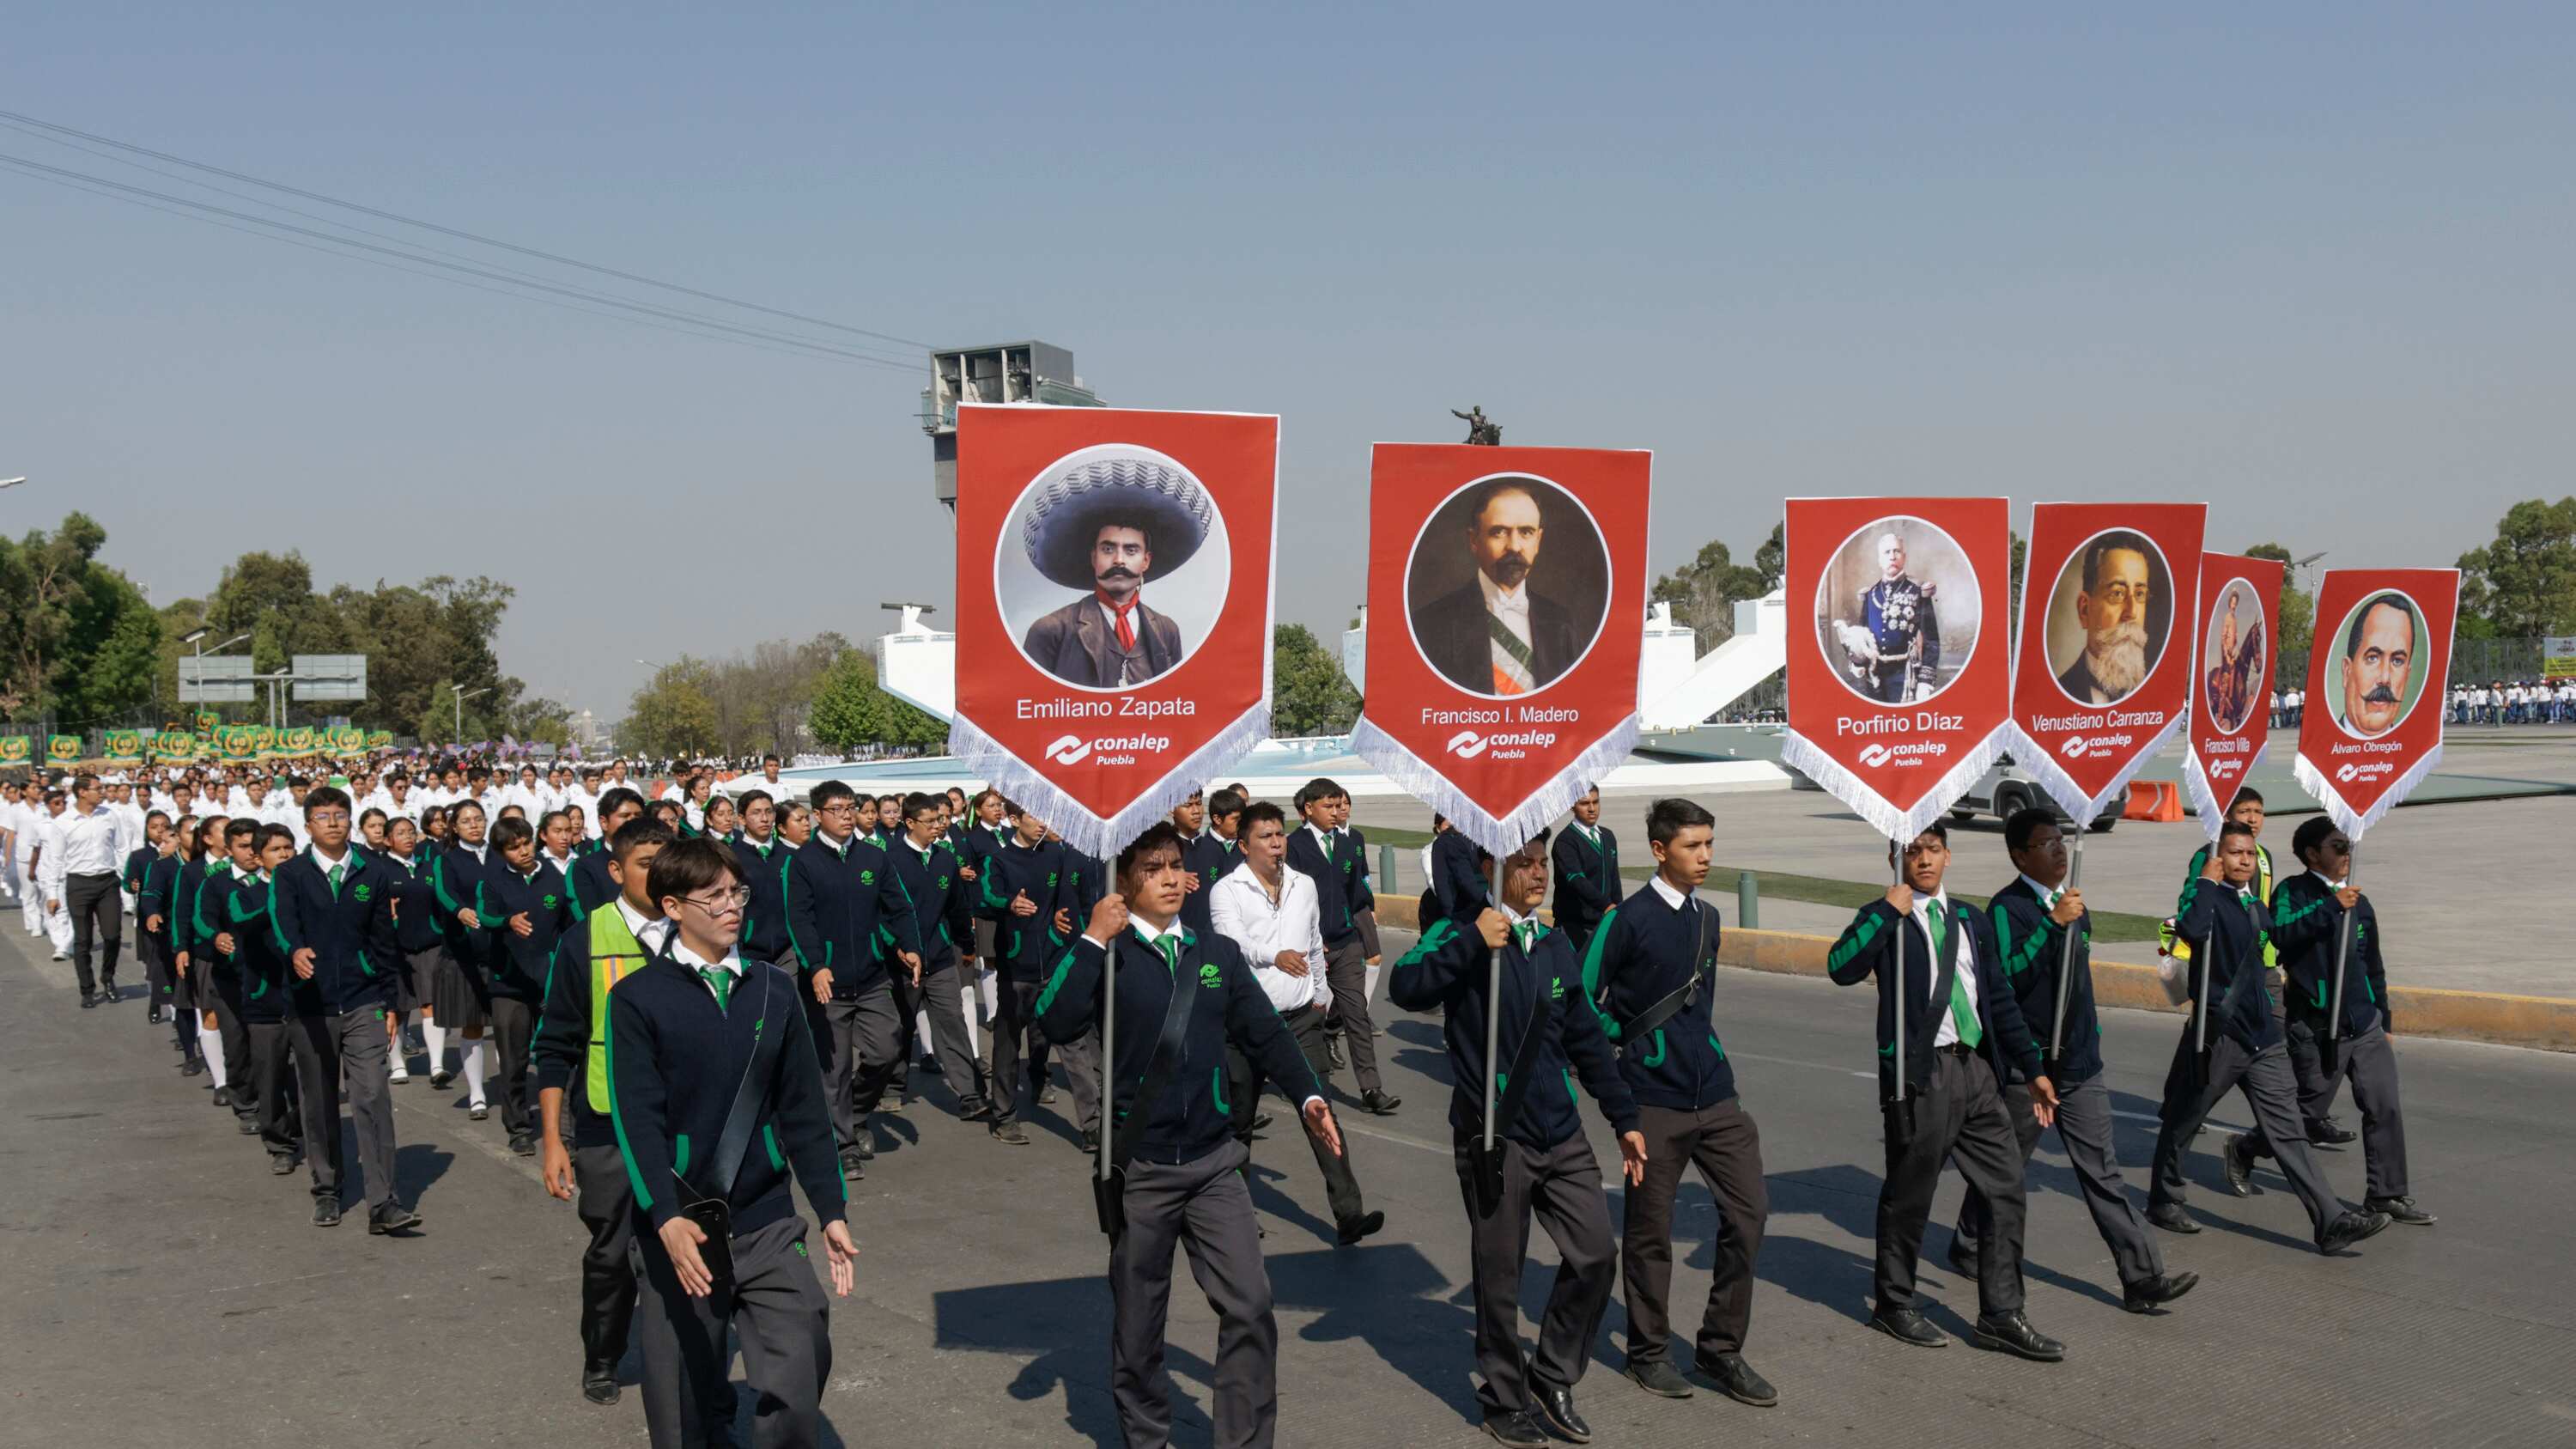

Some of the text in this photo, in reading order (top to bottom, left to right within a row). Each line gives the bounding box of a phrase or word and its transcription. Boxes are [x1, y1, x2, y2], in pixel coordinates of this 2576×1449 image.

[1017, 697, 1196, 720] Emiliano Zapata
[1422, 706, 1579, 725] Francisco I. Madero
[1837, 711, 1964, 736] Porfirio Díaz
[2032, 709, 2164, 732] Venustiano Carranza
[1094, 734, 1170, 754] conalep
[1490, 729, 1556, 747] conalep
[2089, 733, 2132, 747] conalep
[2205, 736, 2250, 754] Francisco Villa
[1491, 750, 1526, 759] Puebla
[1893, 740, 1947, 756] conalep
[2089, 749, 2111, 758] Puebla
[2331, 740, 2403, 755] Álvaro Obregón
[1097, 754, 1135, 766] Puebla
[1894, 757, 1923, 767] Puebla
[2359, 761, 2393, 774] conalep
